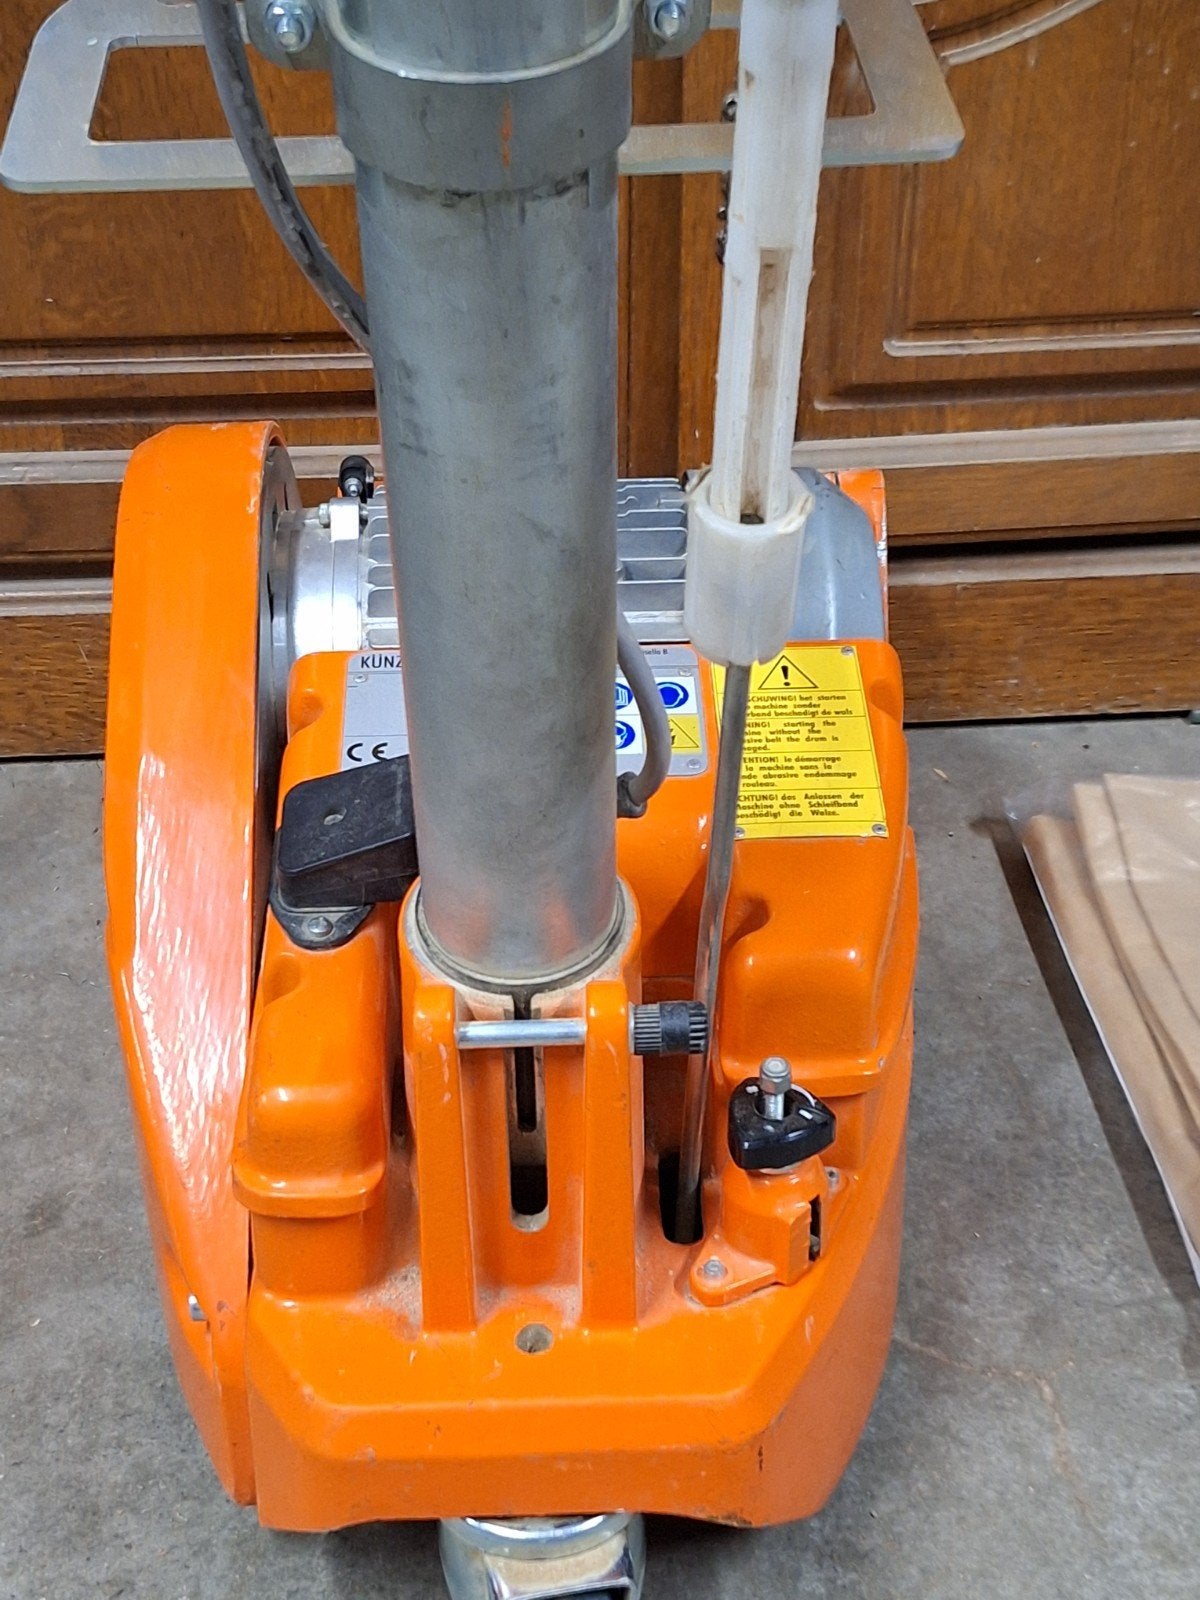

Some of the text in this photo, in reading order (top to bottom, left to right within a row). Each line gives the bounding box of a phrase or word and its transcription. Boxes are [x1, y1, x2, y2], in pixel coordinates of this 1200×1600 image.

[361, 654, 402, 669] KÜNZ
[783, 721, 816, 730] starting
[745, 745, 770, 753] aged.
[804, 771, 857, 779] endommage
[738, 794, 778, 802] CHTUNG!
[808, 800, 858, 808] Schleifband
